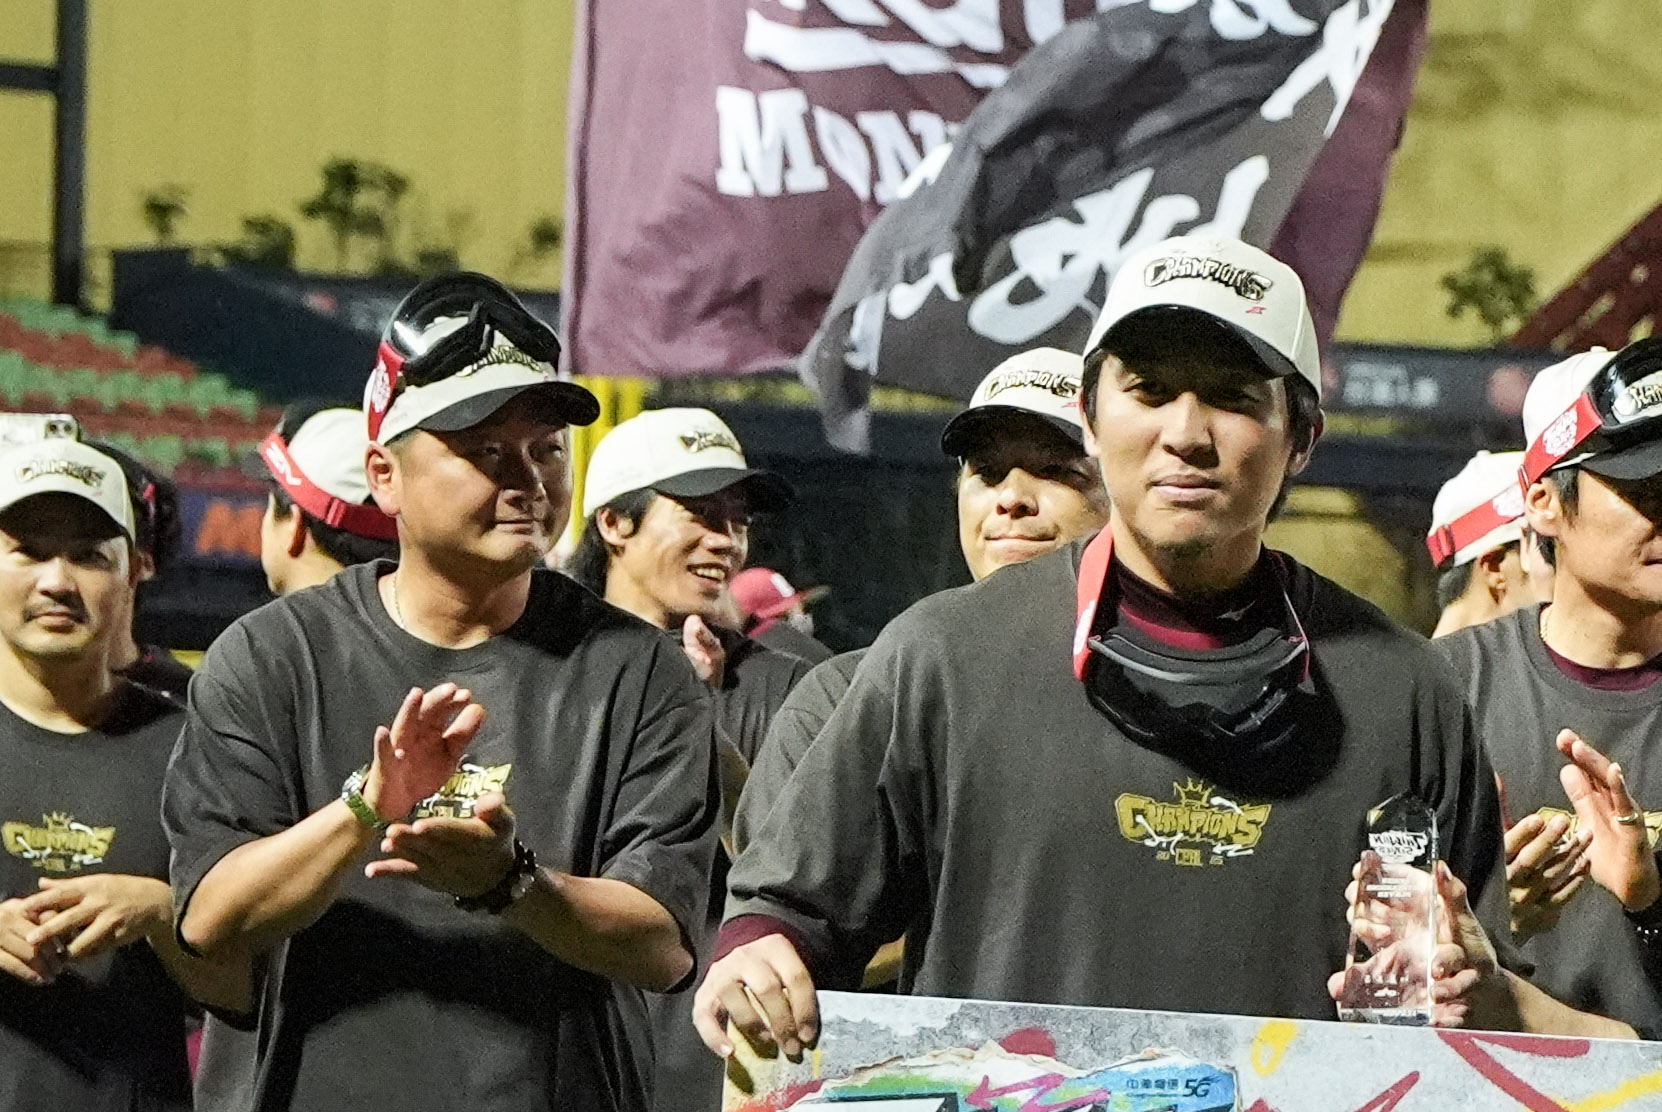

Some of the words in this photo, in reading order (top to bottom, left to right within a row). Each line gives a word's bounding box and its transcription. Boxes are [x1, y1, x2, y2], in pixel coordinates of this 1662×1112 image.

[1143, 256, 1273, 302] CHAMPIONS
[1116, 793, 1272, 848] CHAMPIONS
[1182, 1077, 1221, 1098] 5G
